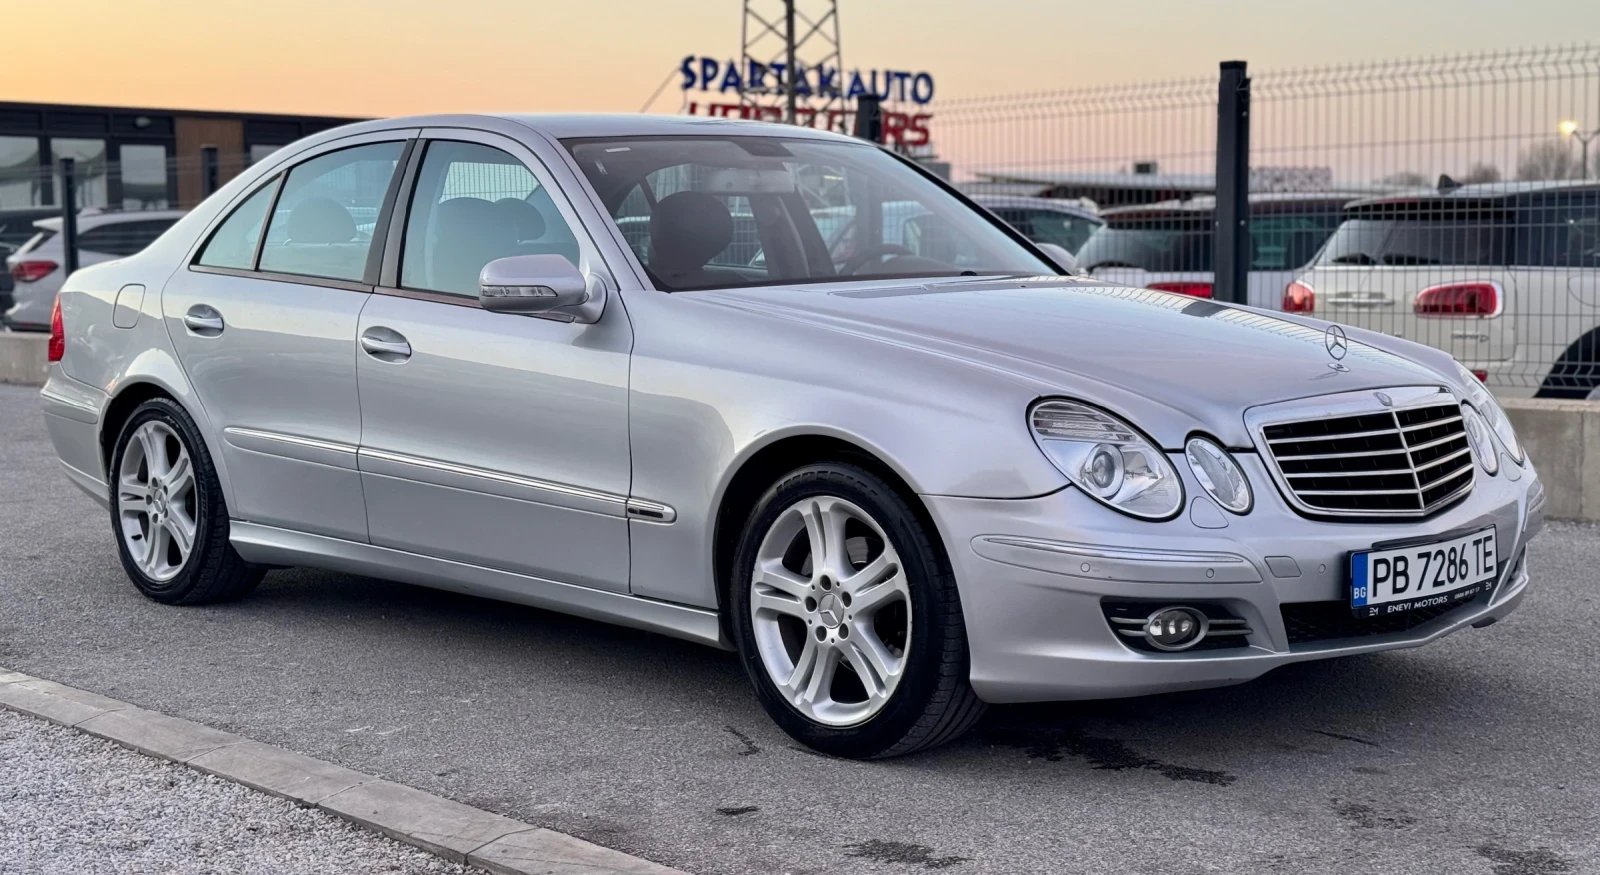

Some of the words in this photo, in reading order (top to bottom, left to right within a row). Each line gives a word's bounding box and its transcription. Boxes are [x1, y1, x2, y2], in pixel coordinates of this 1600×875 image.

[681, 56, 843, 98] SPARTAK
[846, 69, 934, 104] AUTO
[1372, 555, 1410, 598] PB
[1416, 543, 1469, 592] 7286
[1472, 535, 1494, 577] TE
[1353, 586, 1367, 600] BG
[1387, 602, 1412, 613] ENEVI
[1413, 595, 1448, 609] MOTORS
